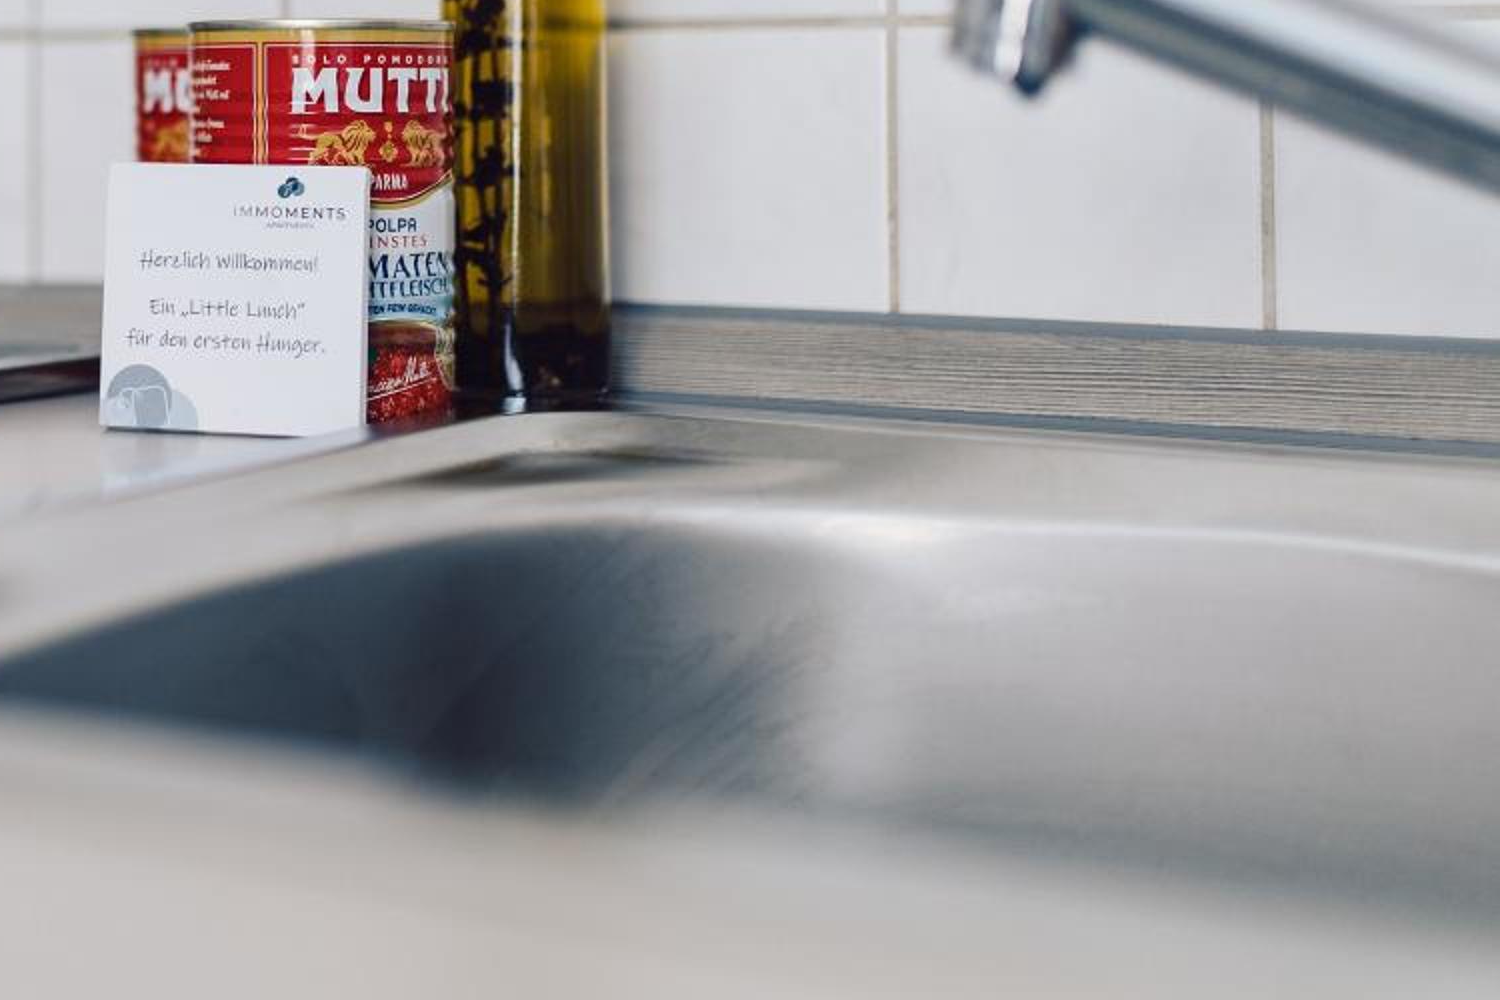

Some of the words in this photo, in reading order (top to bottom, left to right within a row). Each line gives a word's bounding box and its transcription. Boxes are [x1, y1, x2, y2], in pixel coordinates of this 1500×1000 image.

[291, 67, 449, 114] MUTTI
[233, 205, 347, 220] IMMOMENTS
[370, 233, 428, 249] INSTES
[140, 249, 212, 271] Herzlich
[369, 251, 451, 279] MATEN
[149, 298, 176, 316] Ein
[124, 328, 154, 347] für
[159, 329, 188, 348] den
[192, 333, 252, 350] ersten
[256, 331, 326, 359] Hunger.
